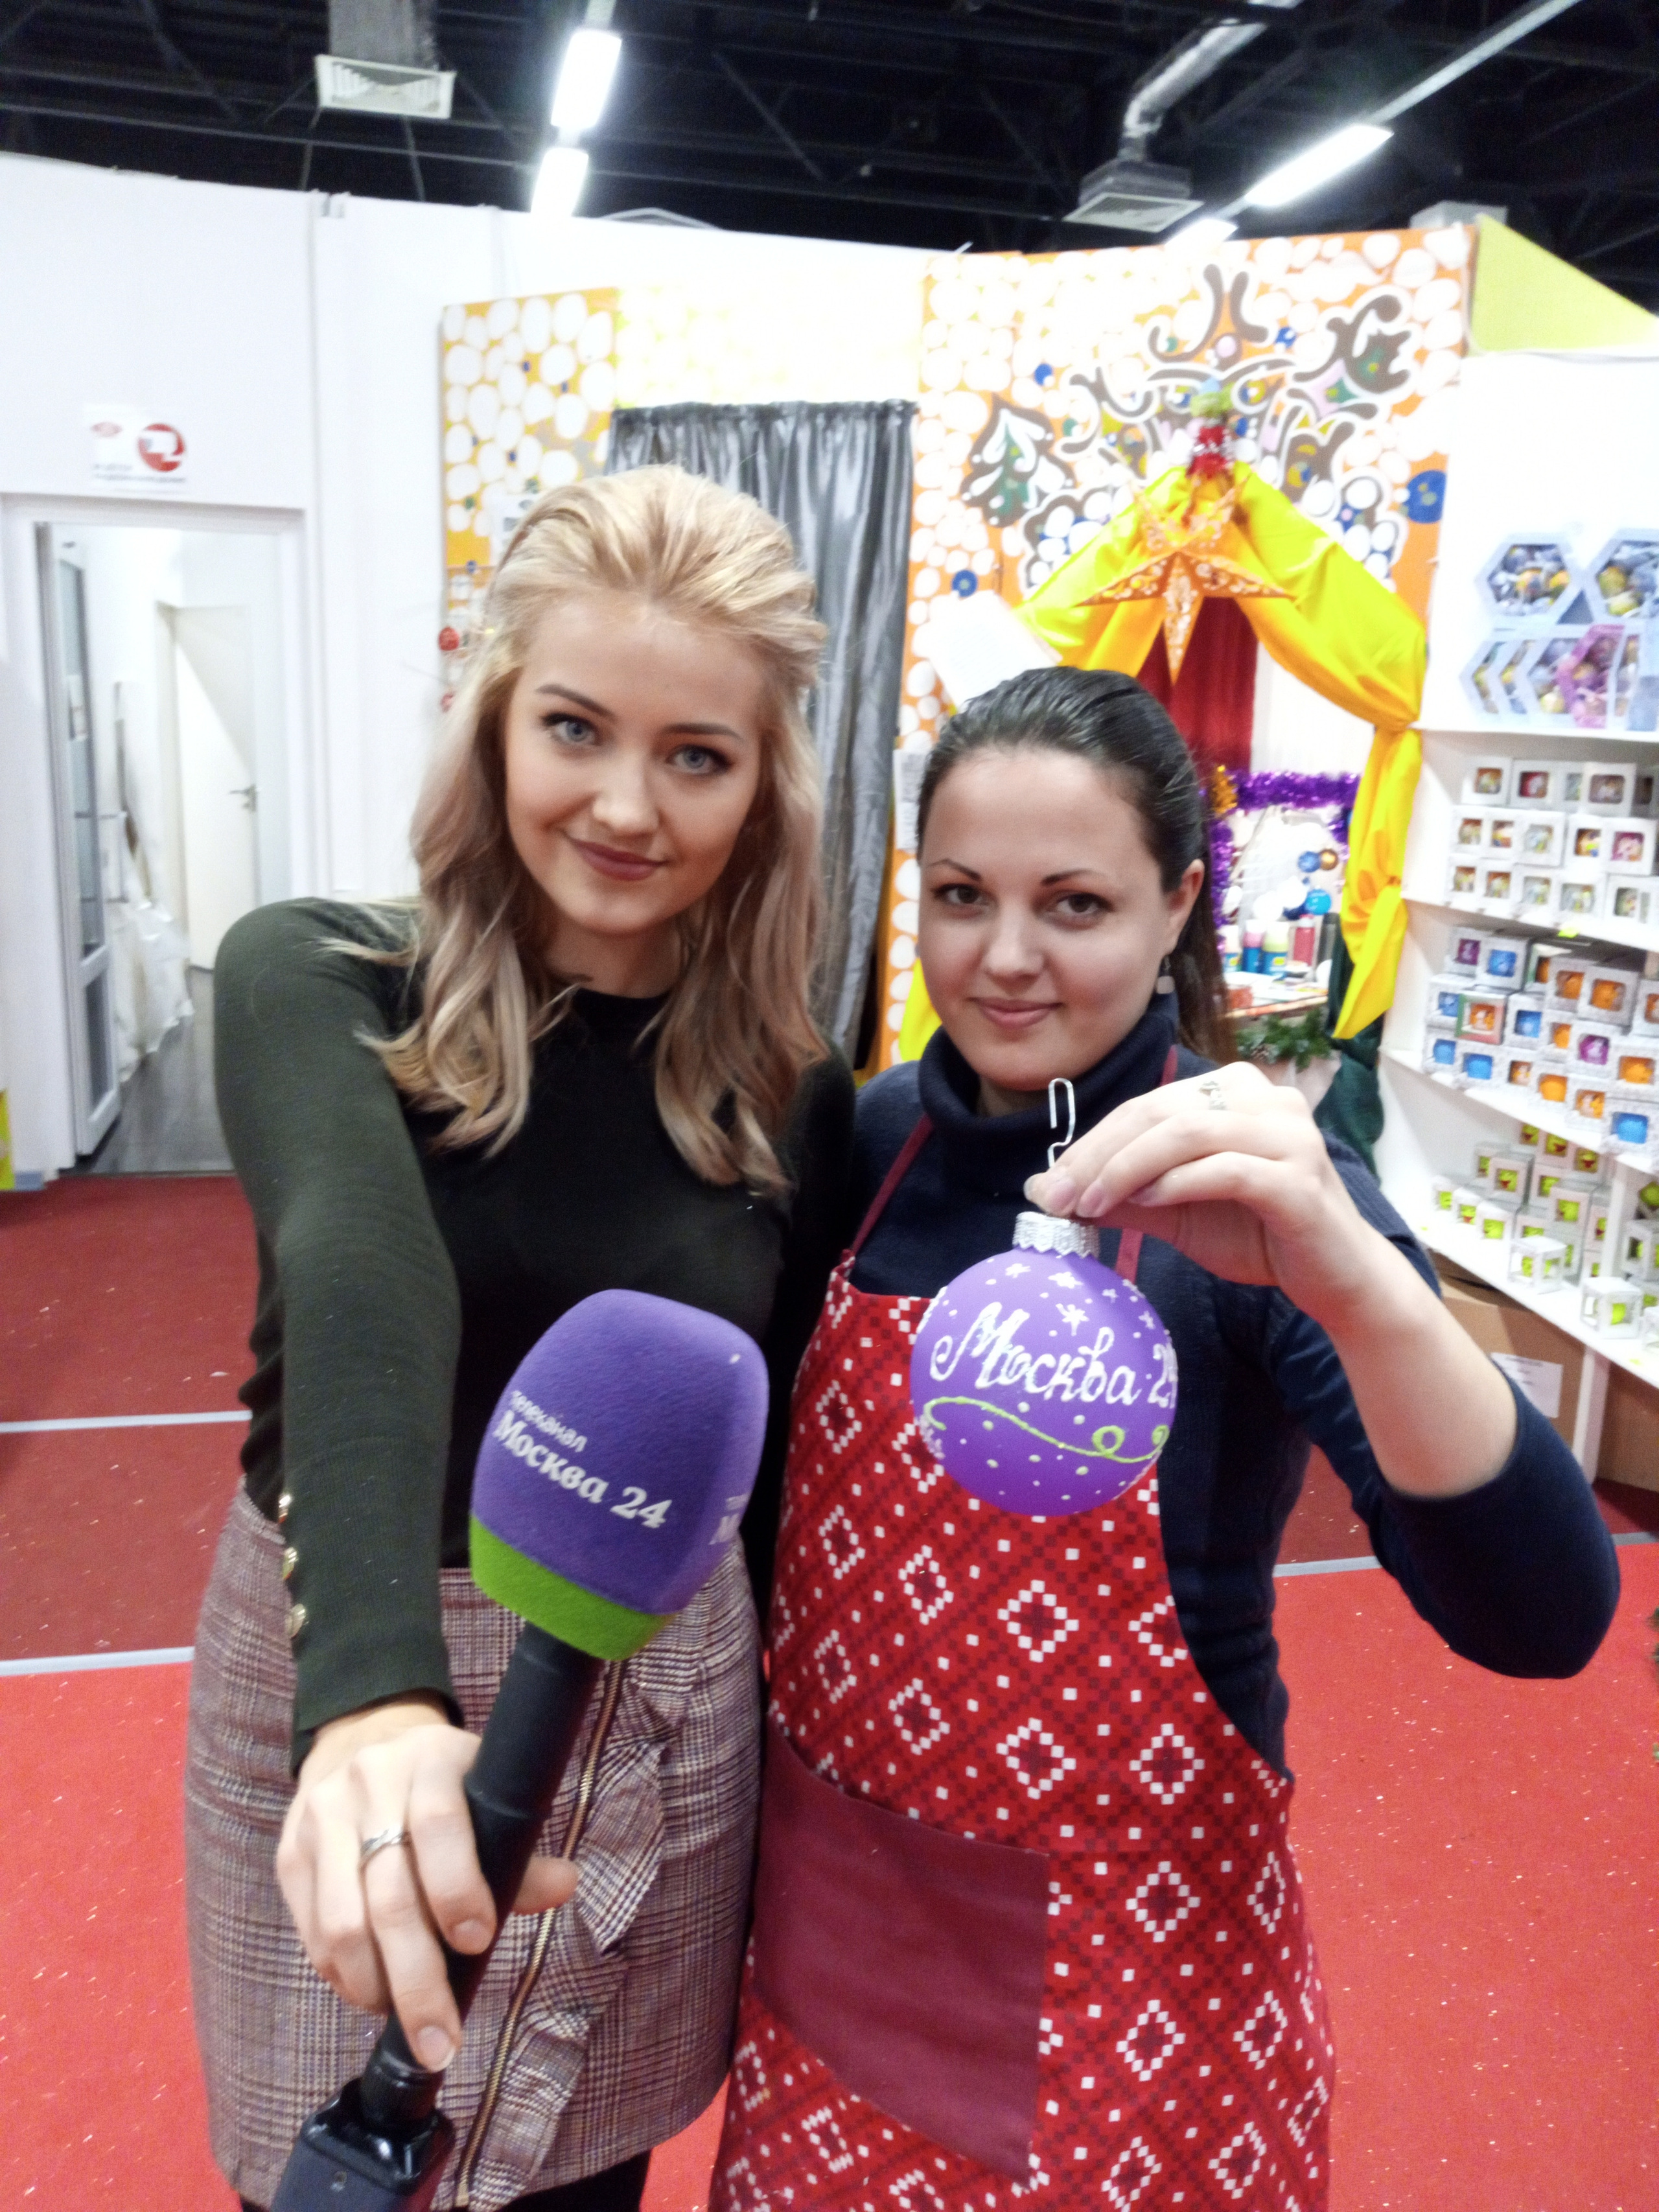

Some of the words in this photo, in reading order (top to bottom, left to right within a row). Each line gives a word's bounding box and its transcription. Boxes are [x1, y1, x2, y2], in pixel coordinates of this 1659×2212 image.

[930, 1302, 1141, 1405] Москва
[493, 1409, 609, 1504] Москва
[610, 1486, 673, 1528] 24
